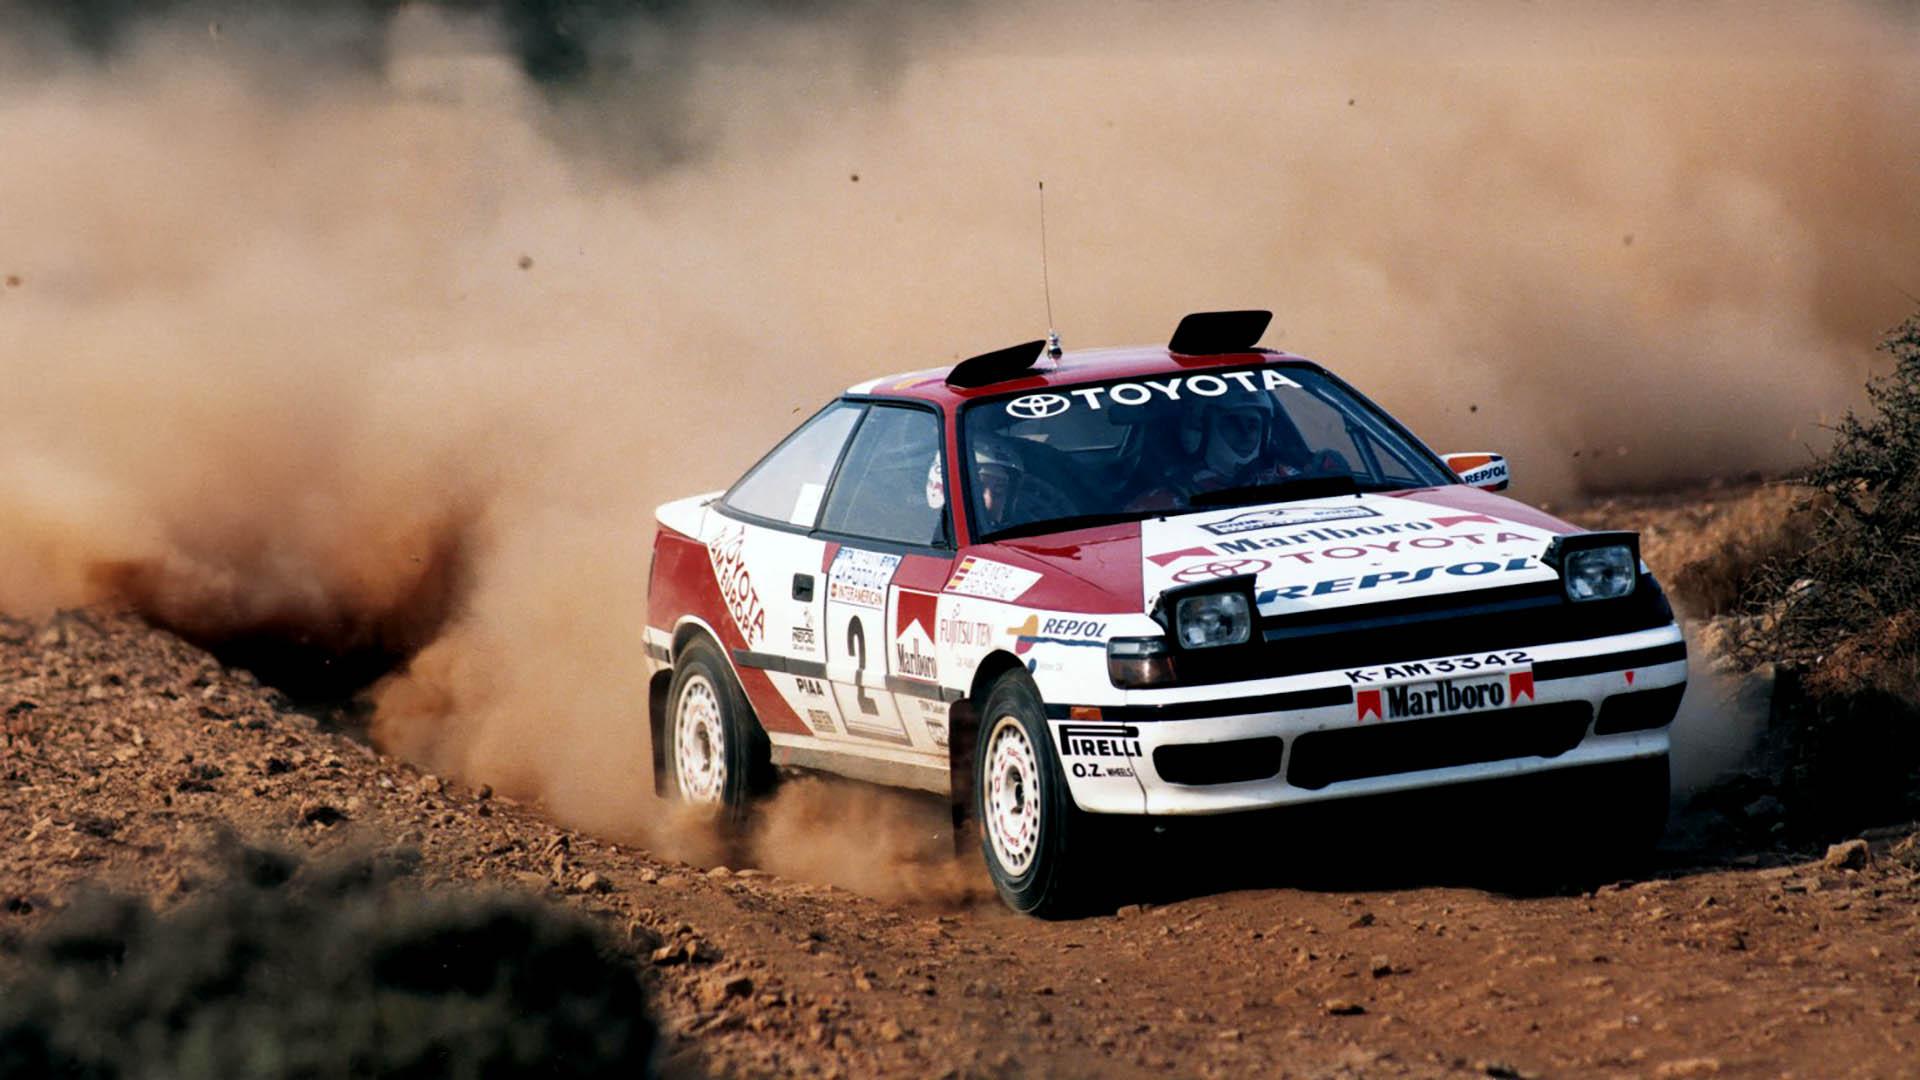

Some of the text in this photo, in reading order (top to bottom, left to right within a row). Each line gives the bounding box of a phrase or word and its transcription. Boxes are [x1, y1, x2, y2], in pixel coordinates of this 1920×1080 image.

[1071, 369, 1303, 410] TOYOTA
[1464, 465, 1507, 484] REPSOL
[1215, 519, 1433, 555] Marlboro
[1280, 531, 1539, 564] TOYOTA
[1256, 557, 1538, 604] REPSOL
[940, 618, 974, 647] FUJITSU
[1042, 618, 1107, 637] REPSOL
[847, 615, 879, 716] 2
[897, 638, 937, 679] Marlboro
[795, 678, 825, 696] PIAA
[1384, 678, 1505, 718] Marlboro
[1058, 724, 1143, 757] PIRELLI
[1072, 762, 1106, 778] O.Z.
